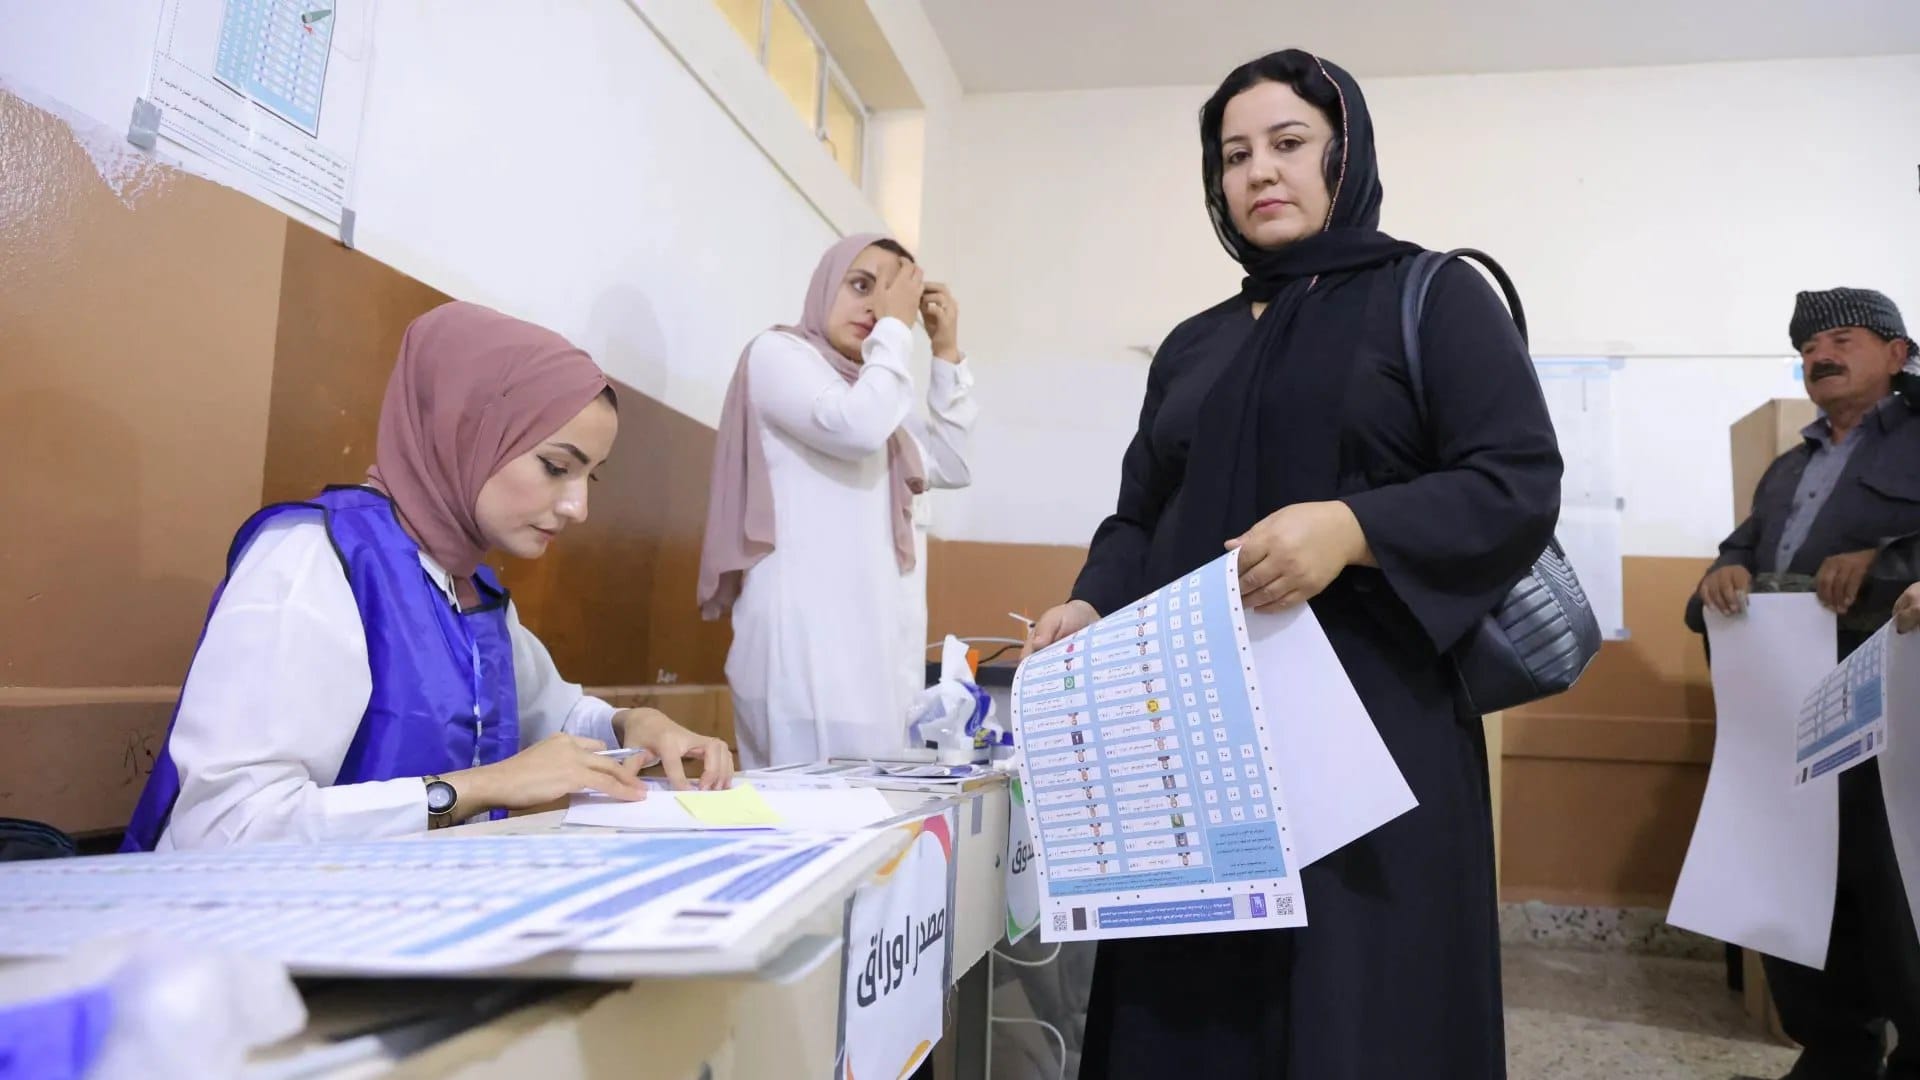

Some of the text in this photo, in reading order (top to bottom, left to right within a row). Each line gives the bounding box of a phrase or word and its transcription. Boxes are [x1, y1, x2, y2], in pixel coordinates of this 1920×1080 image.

[1011, 840, 1035, 875] دوق
[857, 908, 945, 1008] مصدر اوراق
